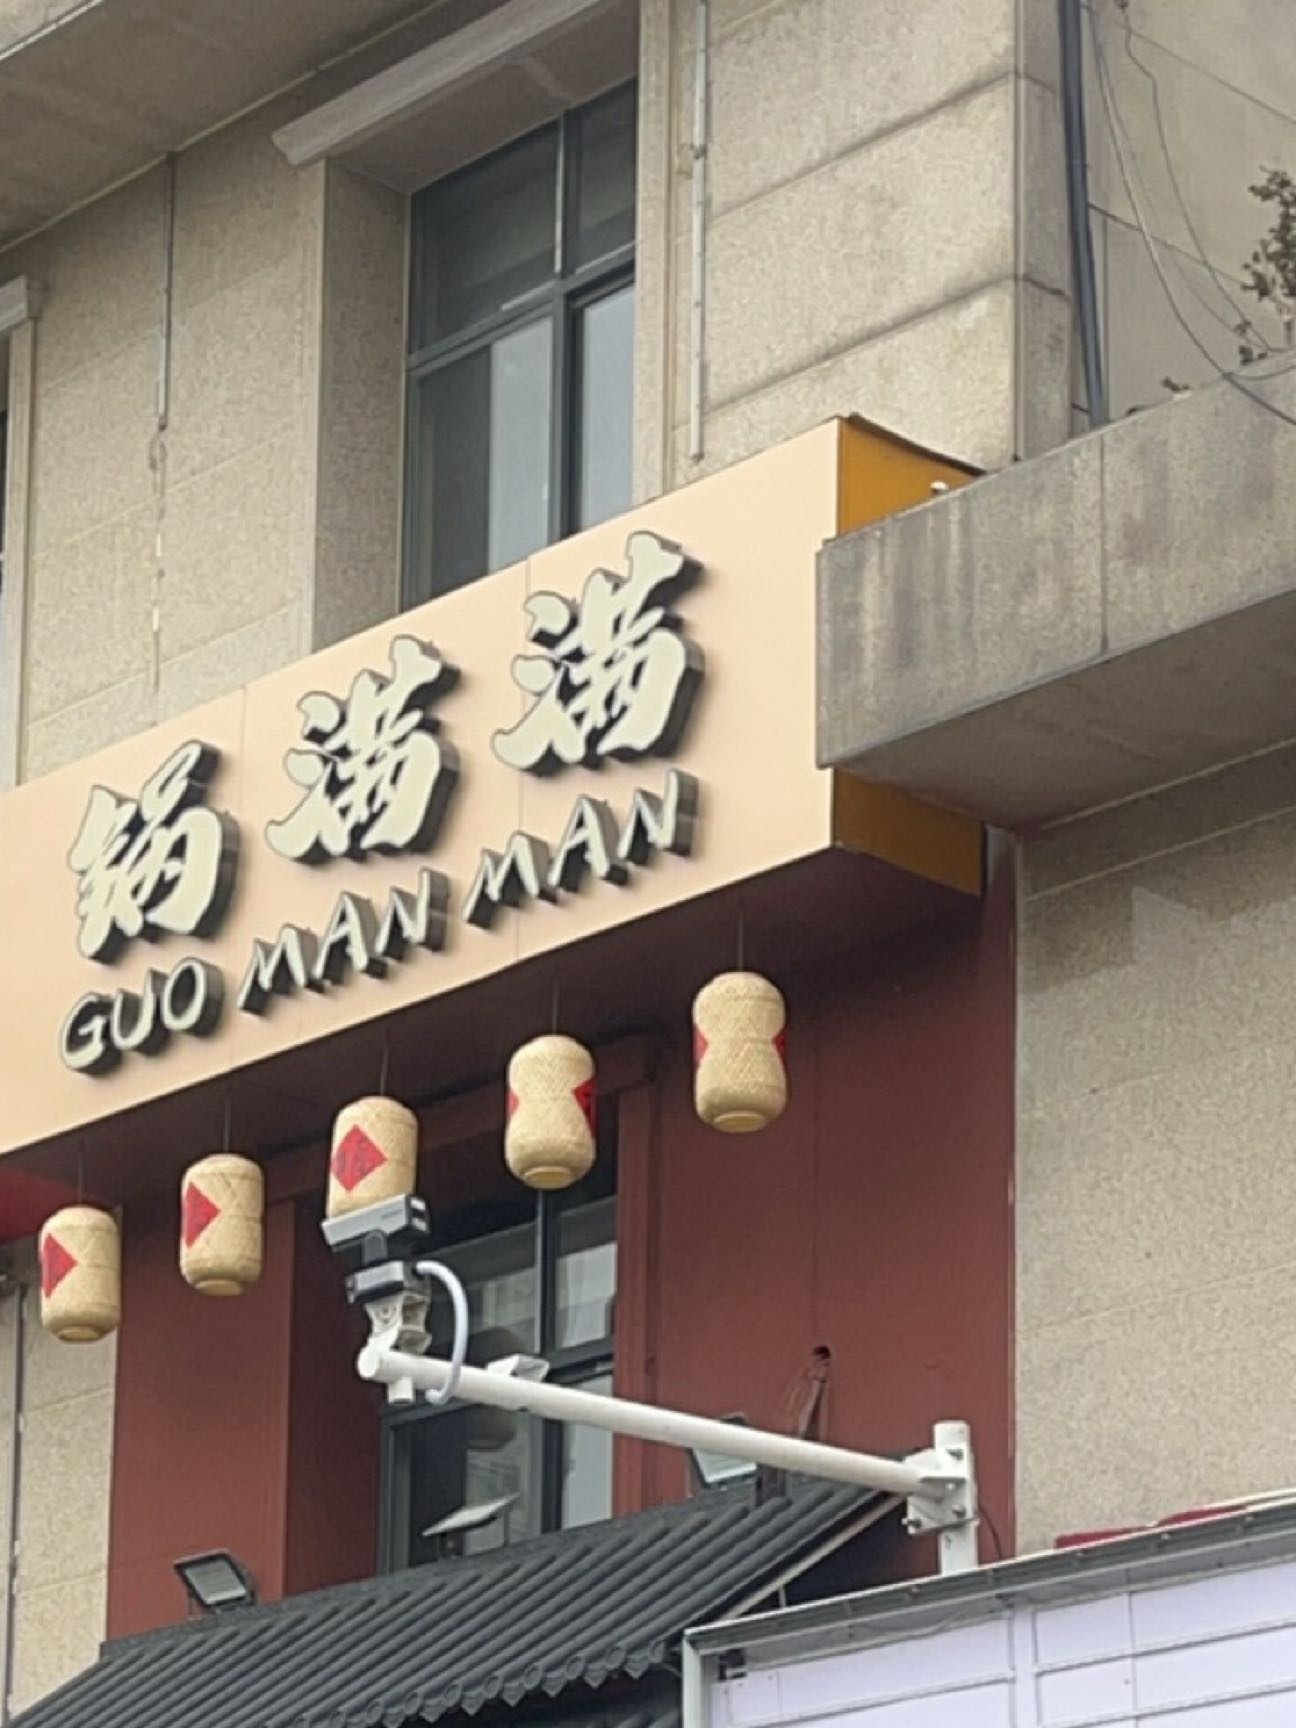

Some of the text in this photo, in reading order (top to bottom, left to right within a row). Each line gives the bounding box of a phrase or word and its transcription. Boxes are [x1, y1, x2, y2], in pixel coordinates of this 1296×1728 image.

[61, 767, 684, 1071] GUO MAN MAN
[67, 530, 690, 961] 锅满满
